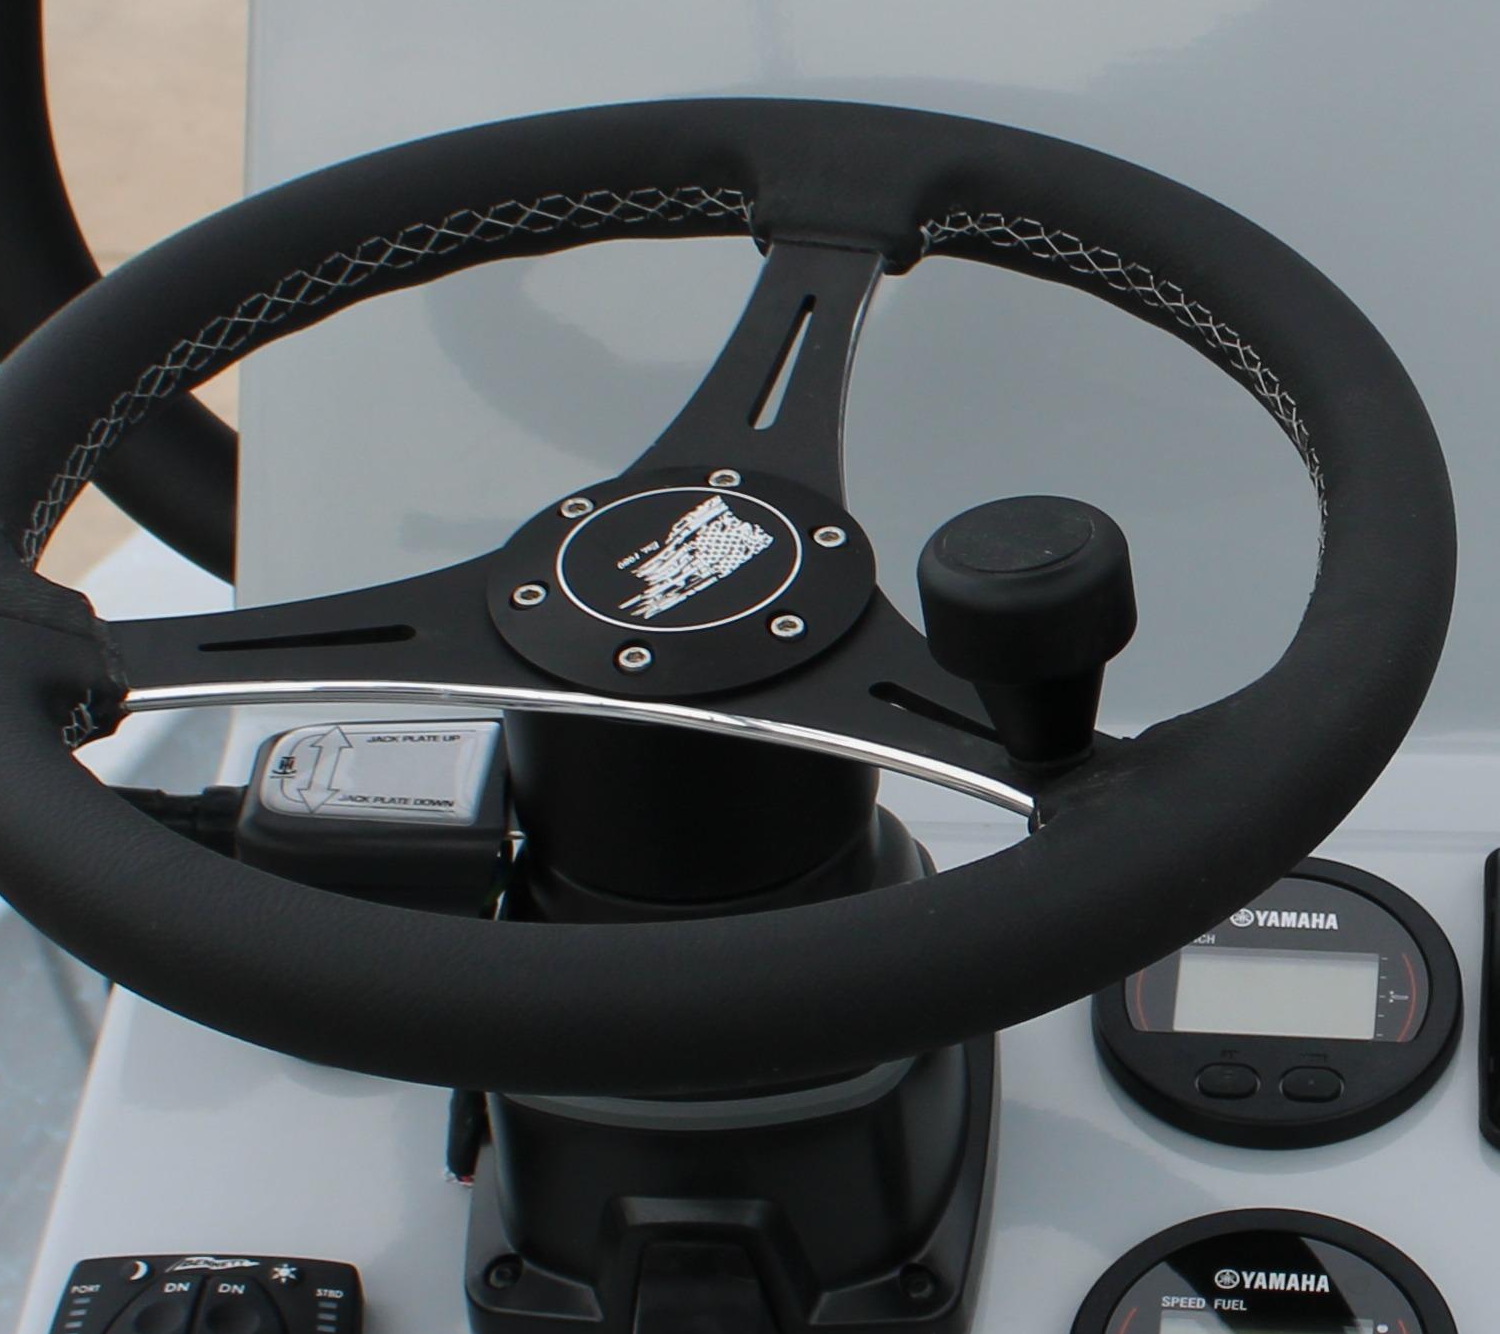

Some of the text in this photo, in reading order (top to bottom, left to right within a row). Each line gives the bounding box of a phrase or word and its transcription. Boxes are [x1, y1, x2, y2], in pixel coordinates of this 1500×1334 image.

[366, 735, 398, 743] JACK
[338, 795, 456, 808] JACK PLATE DOWN
[1255, 910, 1339, 930] YAMAHA
[163, 1282, 191, 1293] DN
[1241, 1271, 1331, 1293] YAMAHA
[71, 1284, 102, 1294] PORT
[217, 1283, 245, 1295] DN
[316, 1288, 344, 1299] STBD
[1161, 1295, 1248, 1311] SPEED FUEL
